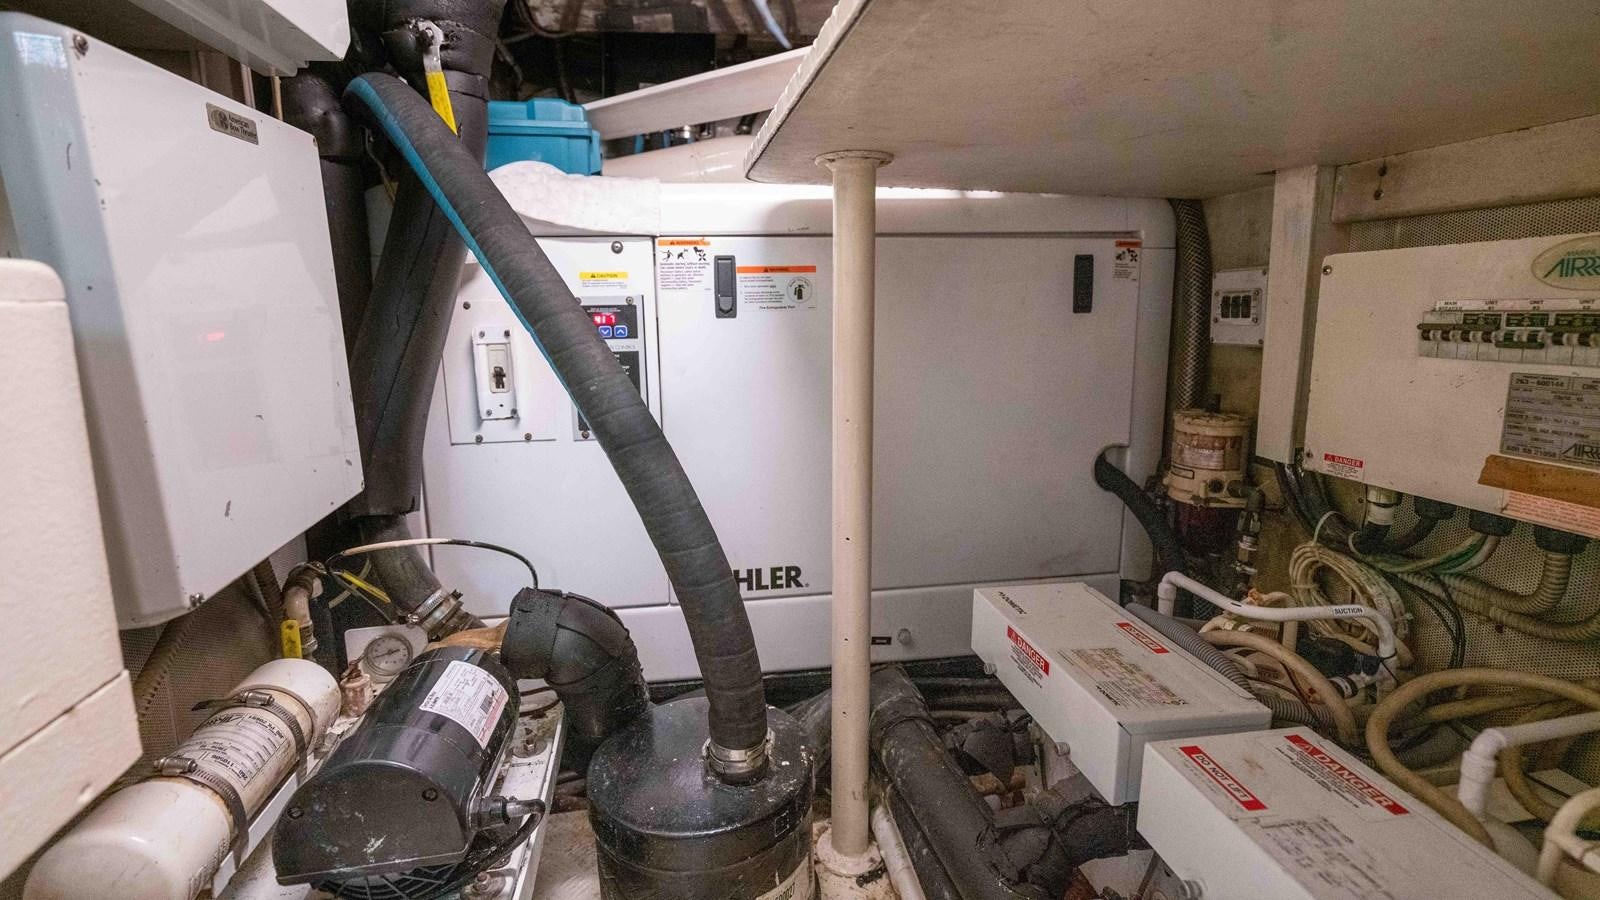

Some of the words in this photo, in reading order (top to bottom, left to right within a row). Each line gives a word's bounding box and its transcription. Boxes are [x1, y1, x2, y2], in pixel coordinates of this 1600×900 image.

[1334, 456, 1361, 467] DANGER
[733, 565, 803, 592] HLER
[1334, 607, 1363, 615] SUCTION
[1017, 636, 1046, 671] DANGER
[1196, 755, 1211, 766] DO
[1209, 766, 1230, 781] NOT
[1227, 783, 1249, 799] LIFT
[1315, 755, 1394, 806] DANGER
